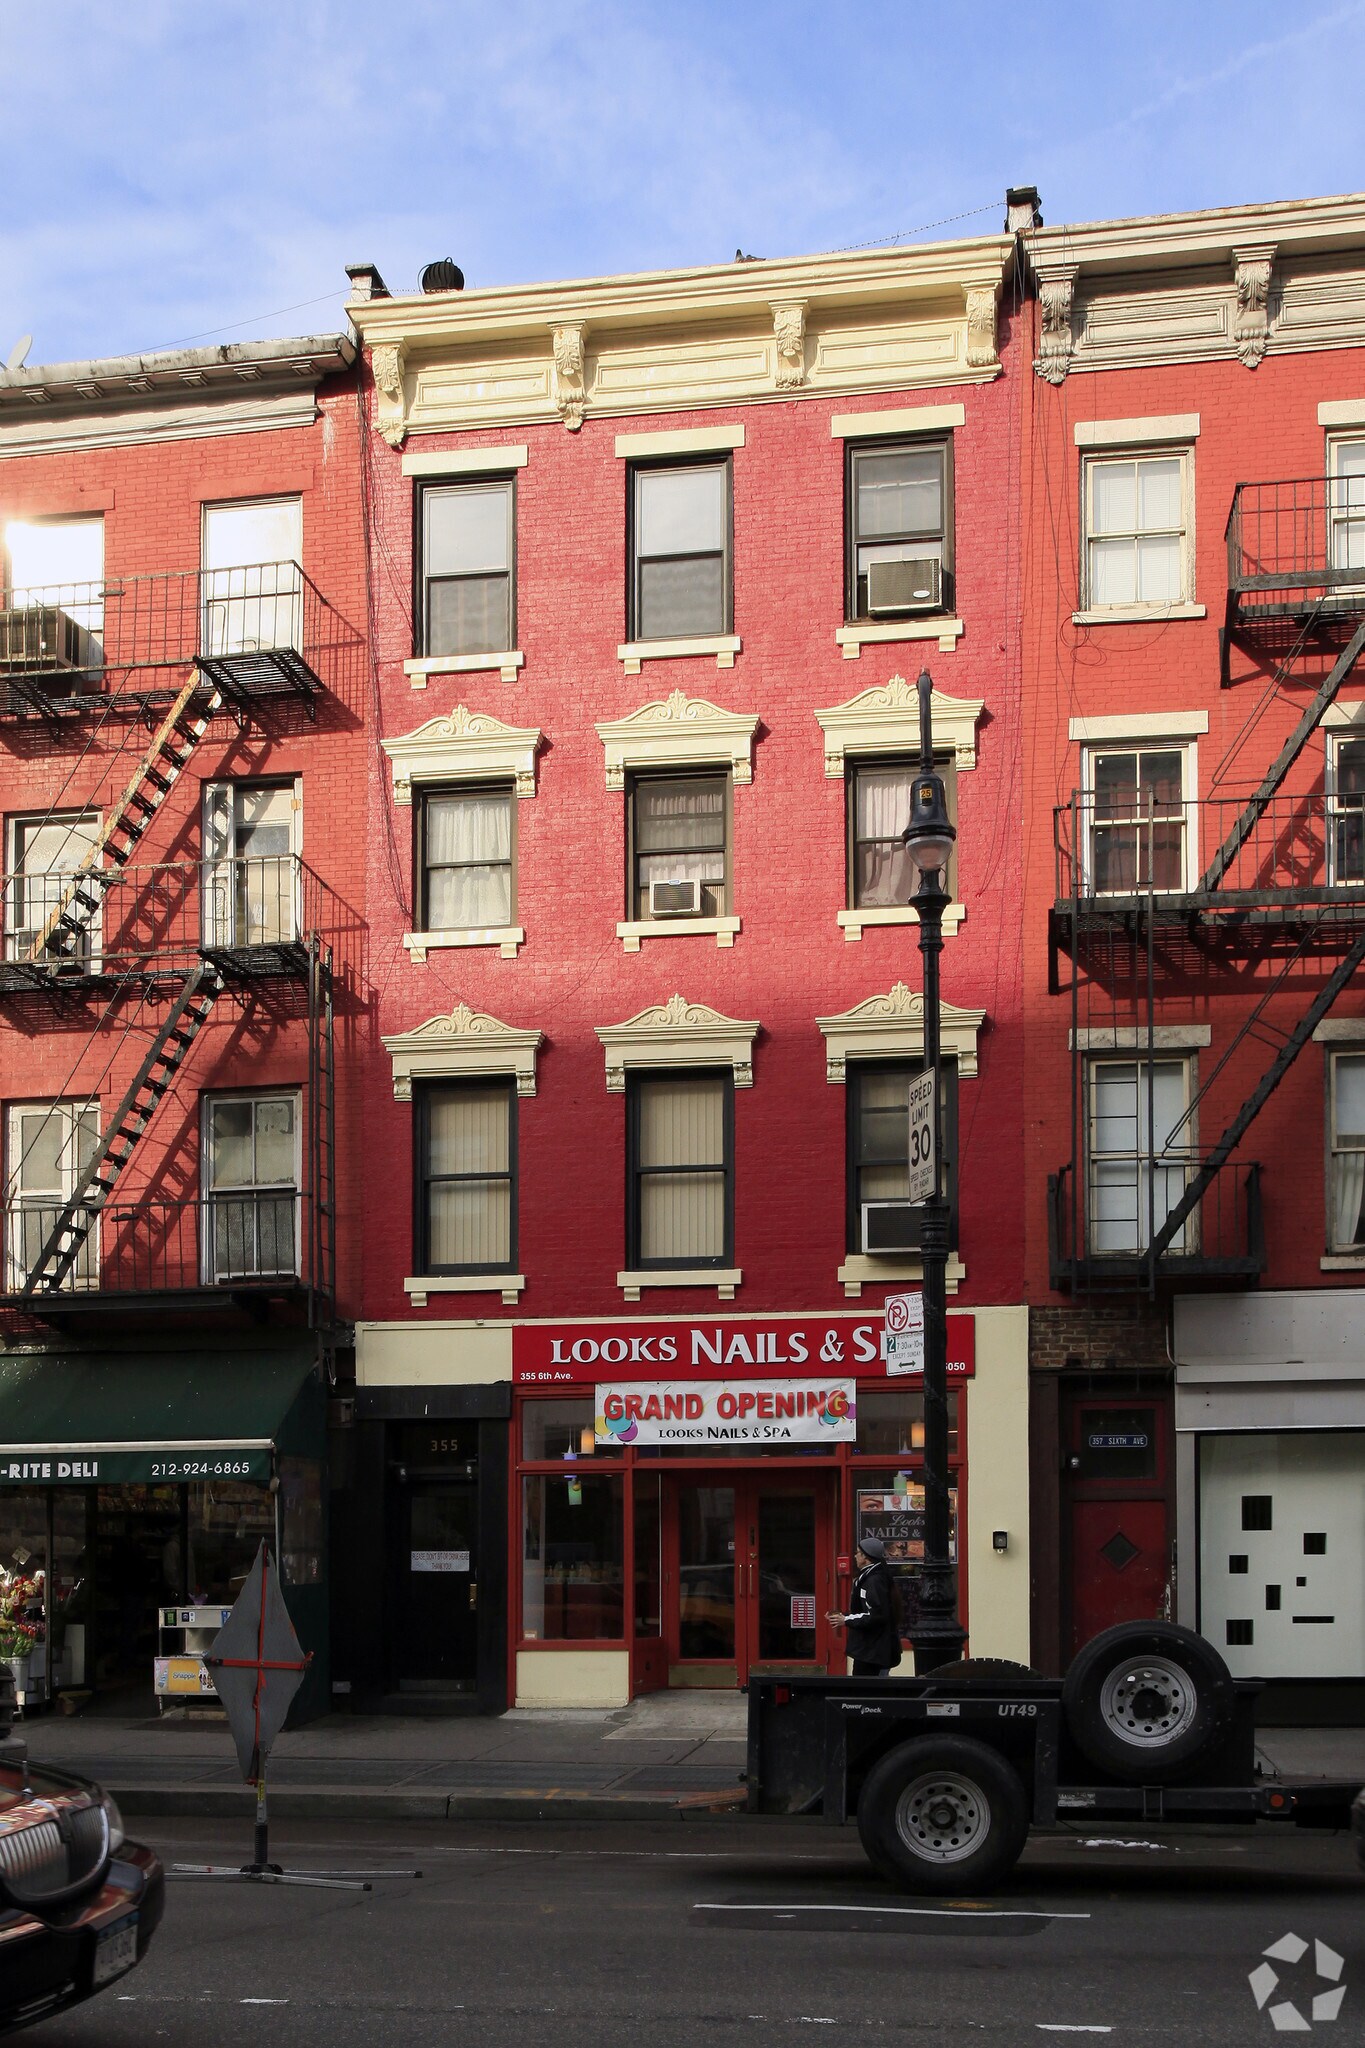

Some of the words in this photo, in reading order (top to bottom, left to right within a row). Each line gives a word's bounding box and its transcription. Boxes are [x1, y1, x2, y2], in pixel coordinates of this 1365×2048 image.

[921, 790, 931, 798] 25
[910, 1081, 932, 1107] SPEED
[912, 1102, 929, 1126] LIMIT
[911, 1123, 931, 1167] 30
[550, 1336, 678, 1364] LOOKS
[690, 1327, 809, 1364] NAILS
[819, 1329, 845, 1363] &
[888, 1337, 896, 1352] 2
[892, 1352, 906, 1360] EXCEPT
[906, 1350, 922, 1358] SUNDAY
[520, 1372, 536, 1380] 355
[538, 1372, 552, 1380] 6th
[554, 1371, 574, 1380] Ave.
[603, 1393, 704, 1421] GRAND
[716, 1389, 850, 1420] OPENING
[658, 1428, 703, 1439] LOOKS
[707, 1426, 749, 1439] NAILS
[752, 1427, 761, 1438] &
[763, 1425, 792, 1438] SPA
[431, 1439, 458, 1451] 355
[57, 1461, 98, 1478] DELI
[151, 1462, 250, 1476] 212-924-6865
[889, 1514, 926, 1527] Looks
[865, 1527, 909, 1538] NAILS
[911, 1528, 921, 1538] &
[172, 1671, 196, 1681] Snapple
[841, 1703, 862, 1711] Power
[864, 1706, 883, 1714] Deck
[997, 1704, 1038, 1717] UT49
